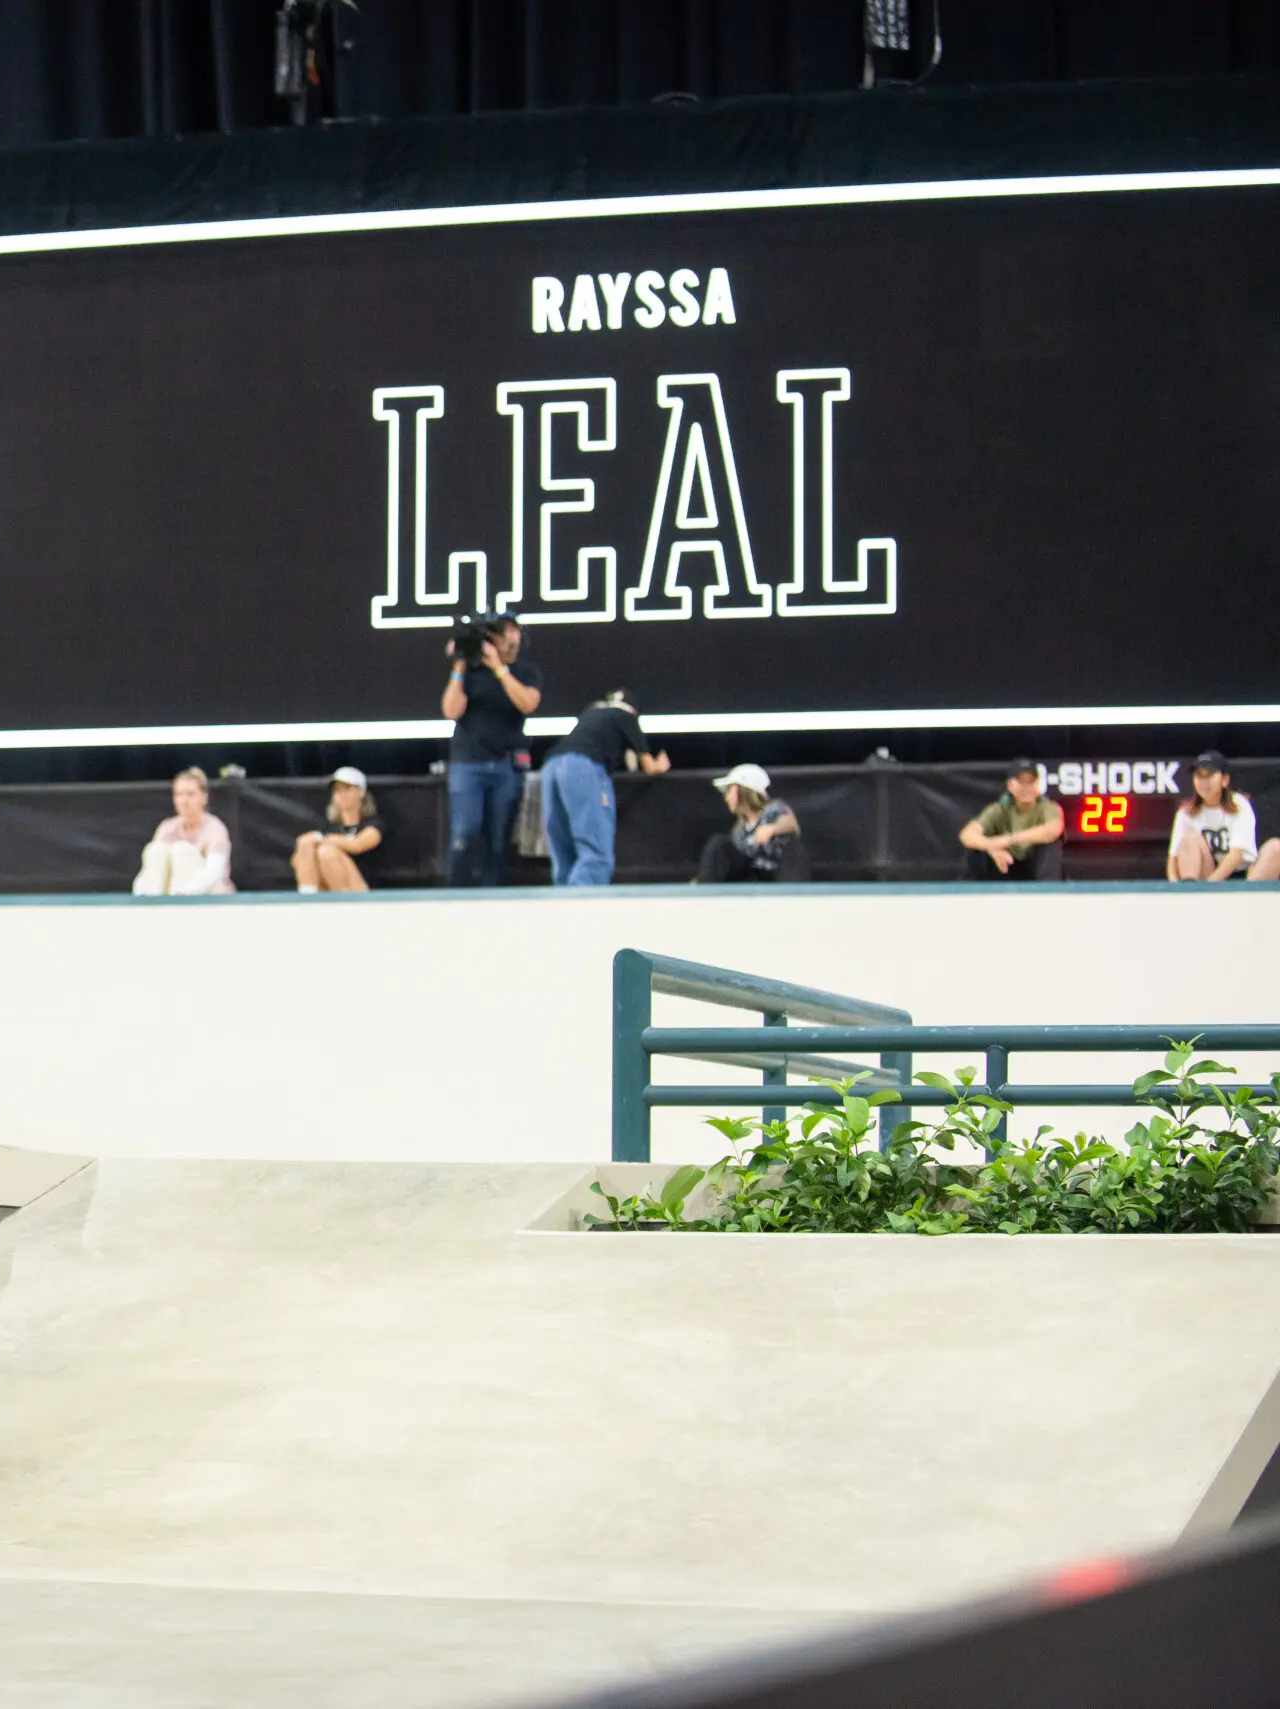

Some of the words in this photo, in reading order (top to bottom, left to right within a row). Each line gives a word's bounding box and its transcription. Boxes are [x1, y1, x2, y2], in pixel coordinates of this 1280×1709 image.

[532, 268, 736, 333] RAYSSA
[371, 367, 897, 628] LEAL
[1081, 797, 1128, 832] 22
